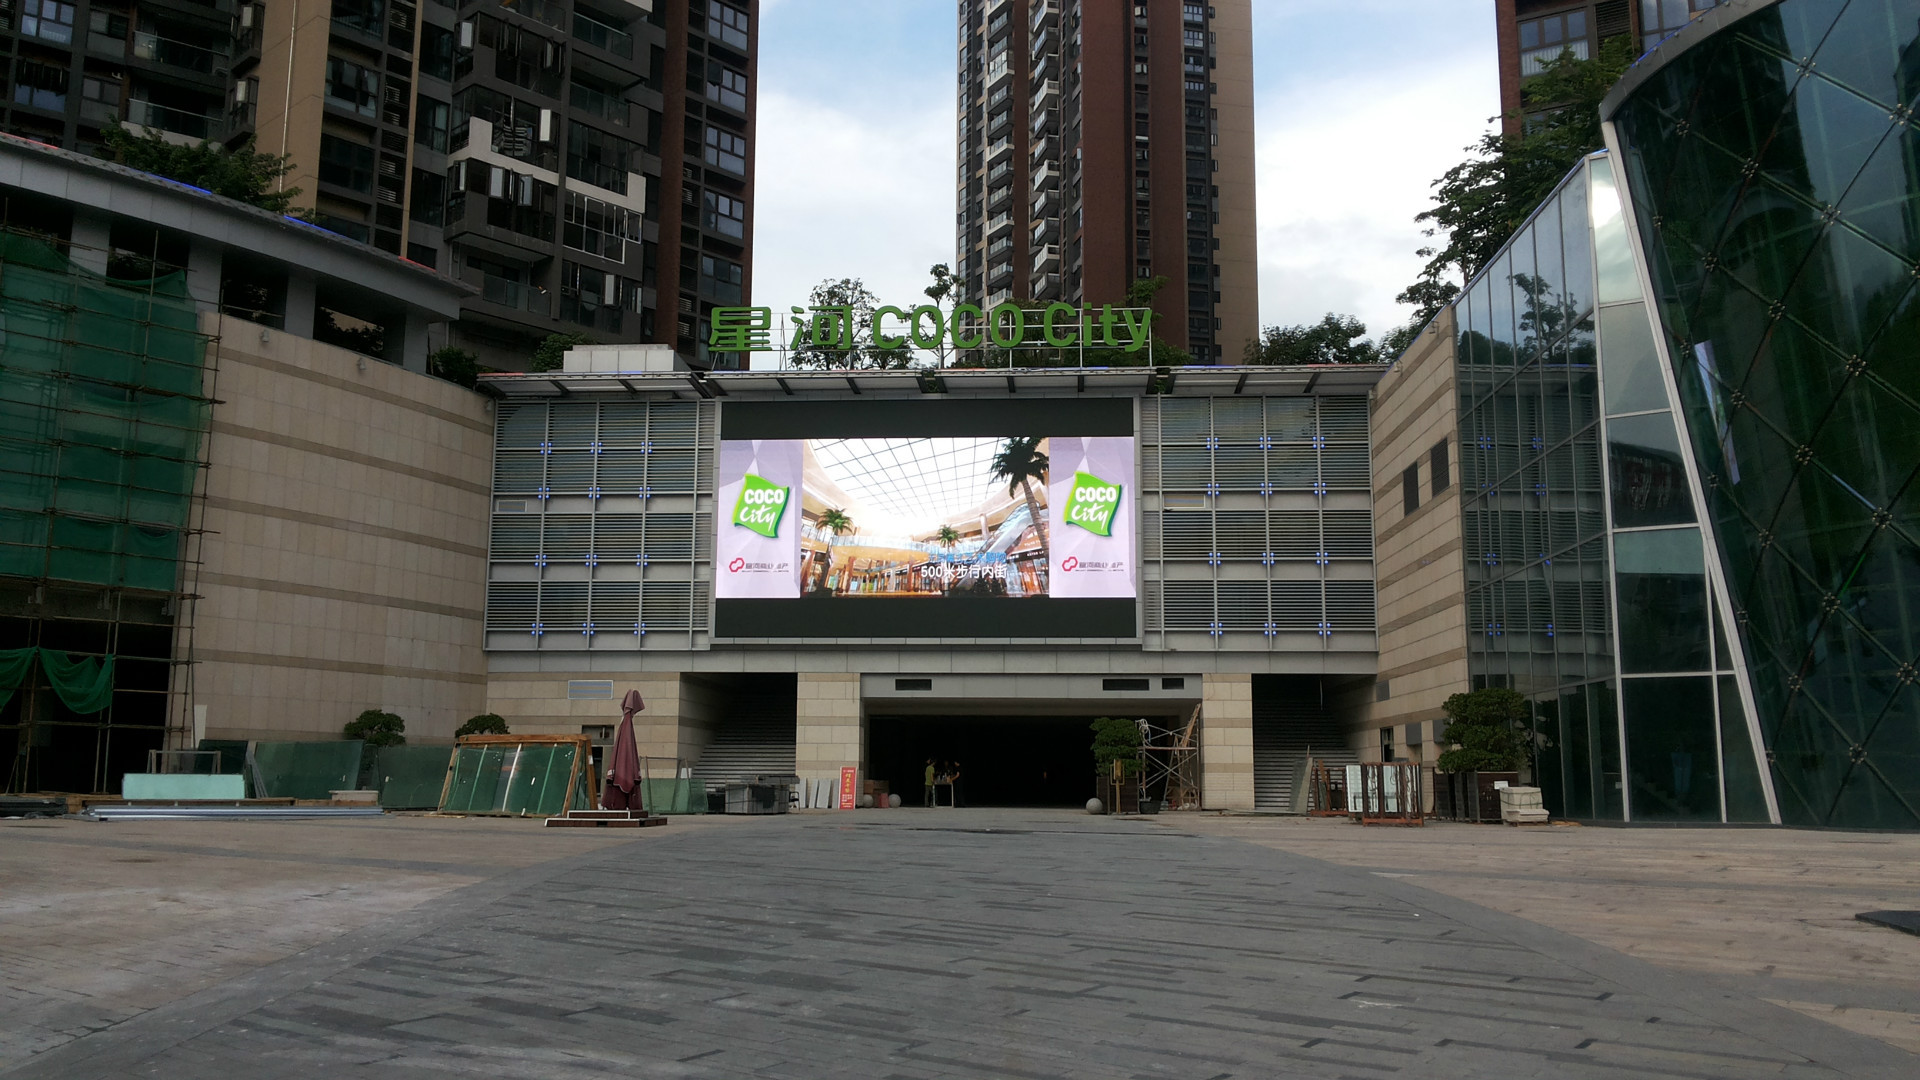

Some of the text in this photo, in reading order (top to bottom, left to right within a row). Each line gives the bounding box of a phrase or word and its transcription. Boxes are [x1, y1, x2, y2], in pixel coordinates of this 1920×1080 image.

[708, 302, 1152, 352] 星河 COCO City
[745, 489, 784, 504] COCO
[1075, 487, 1116, 503] COCO
[740, 505, 776, 531] City
[1072, 503, 1108, 530] City
[920, 563, 1008, 579] 500米步行内街
